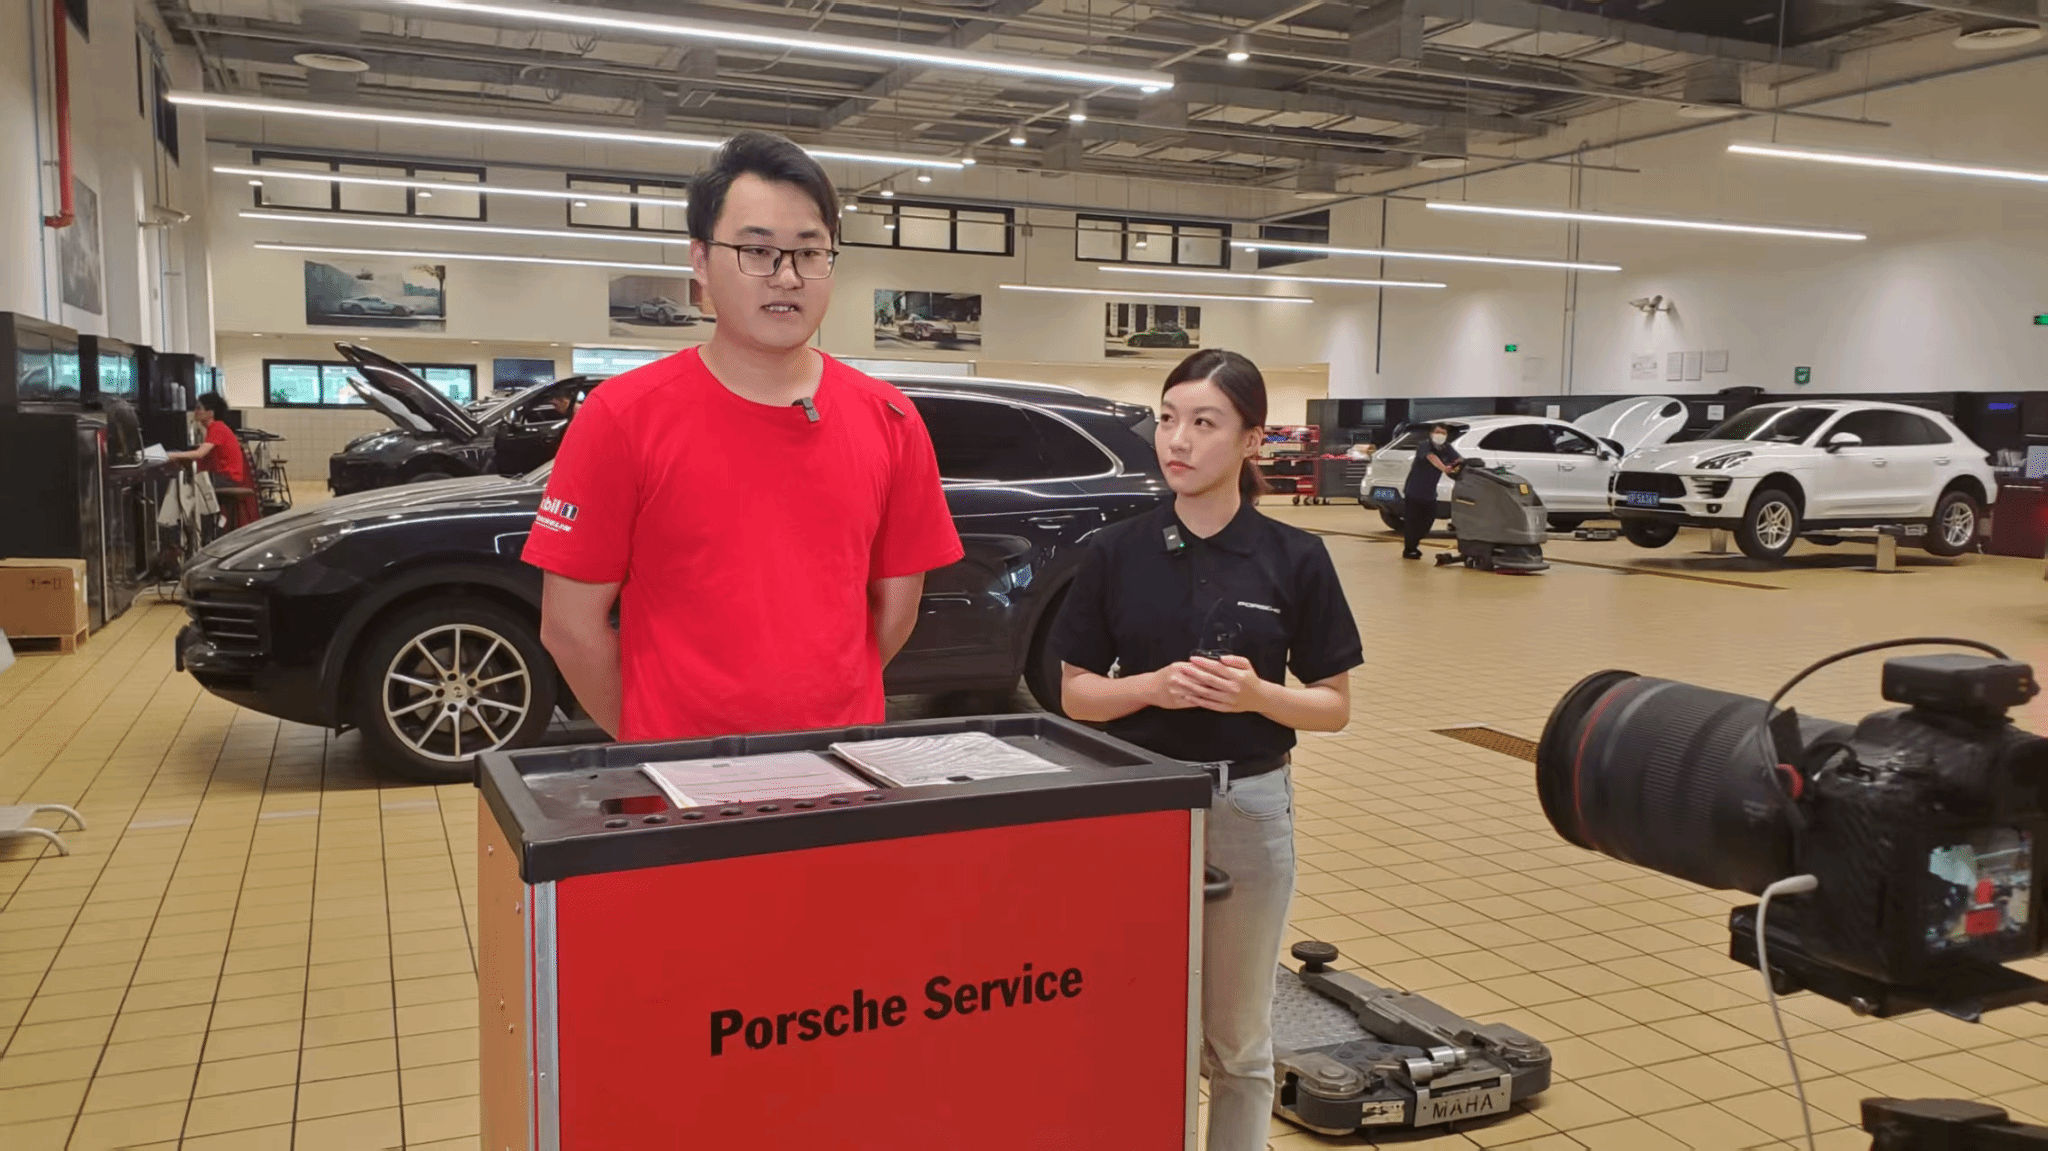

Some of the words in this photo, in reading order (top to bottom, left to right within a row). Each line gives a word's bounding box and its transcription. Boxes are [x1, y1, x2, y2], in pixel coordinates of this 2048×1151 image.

[710, 988, 908, 1057] Porsche
[923, 962, 1083, 1020] Service
[1432, 1093, 1493, 1120] MAHA
